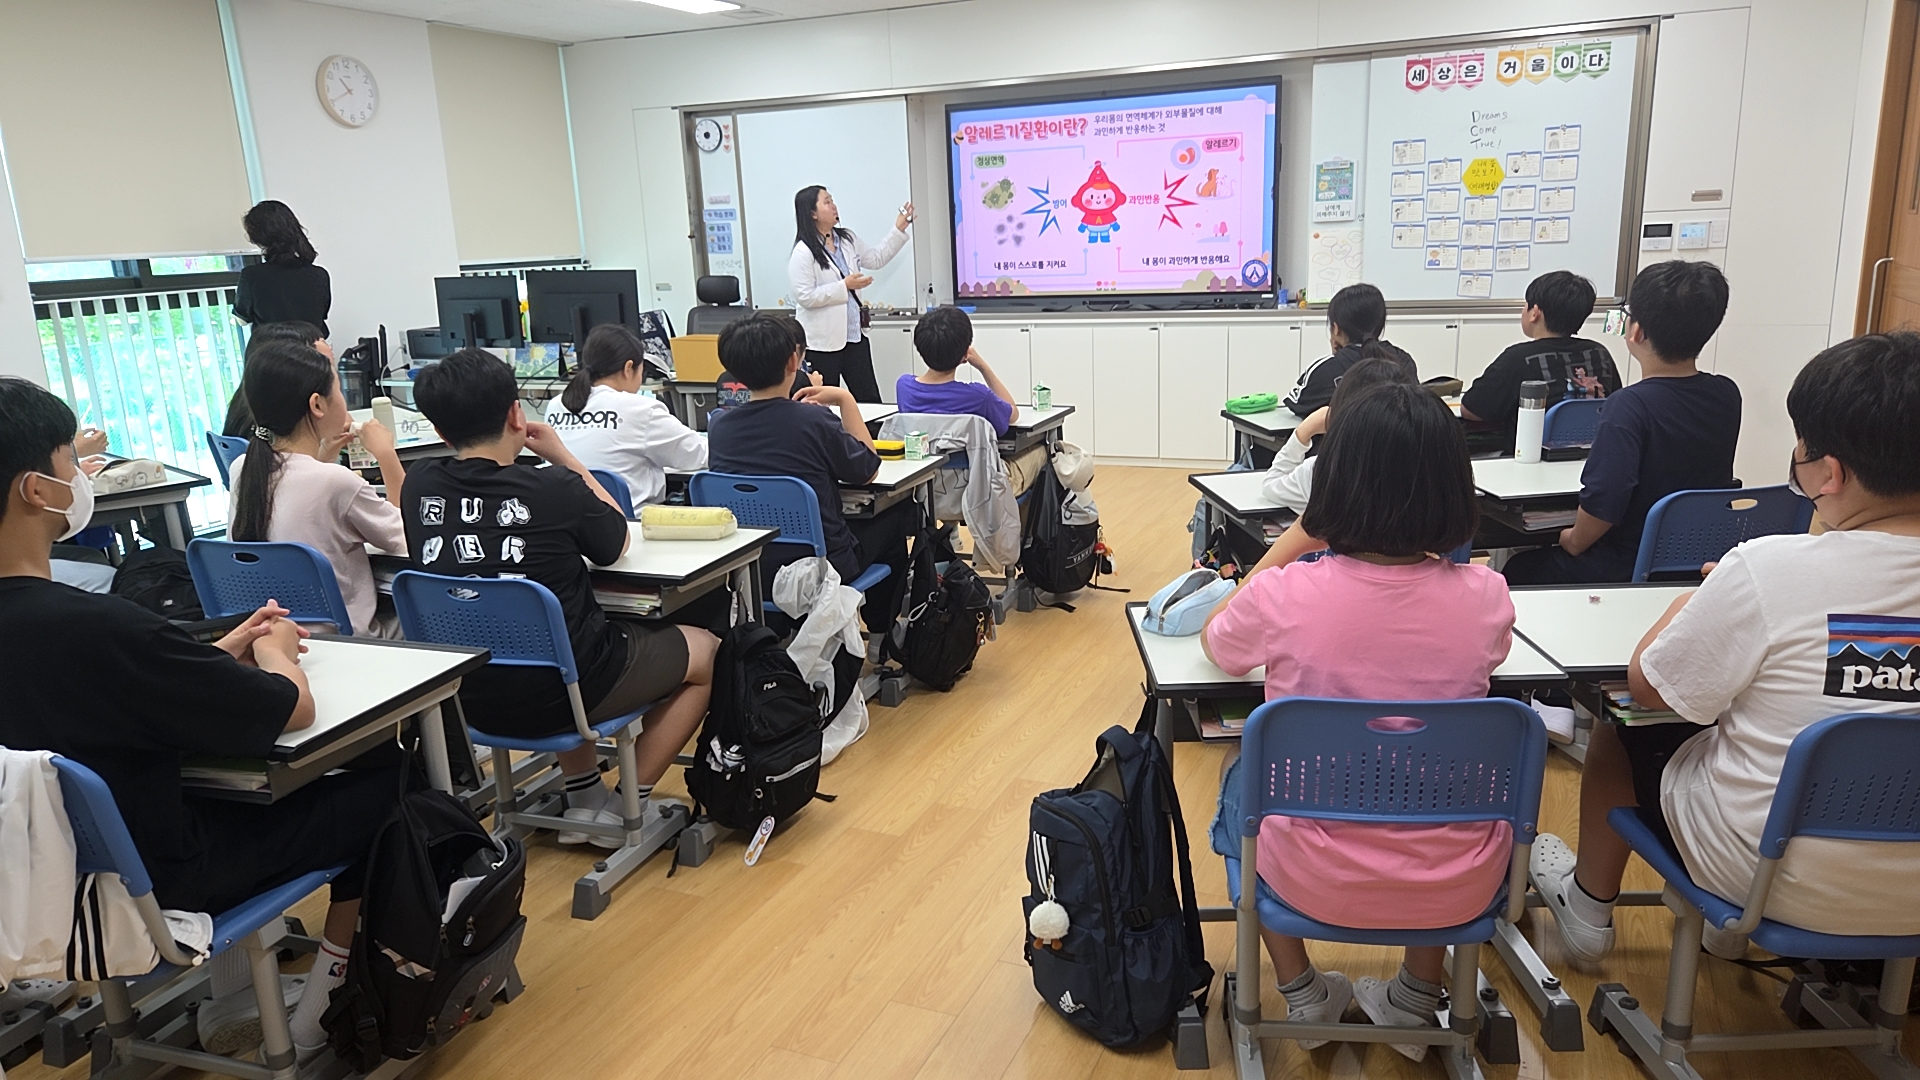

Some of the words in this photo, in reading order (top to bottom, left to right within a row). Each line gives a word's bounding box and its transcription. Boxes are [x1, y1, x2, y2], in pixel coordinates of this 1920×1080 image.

[1411, 64, 1477, 82] 세상은
[1503, 53, 1603, 74] 거울이다
[363, 75, 369, 84] 2
[368, 89, 374, 98] 3
[360, 111, 366, 120] 5
[1094, 113, 1123, 125] 우리몸의
[1125, 110, 1163, 122] 면역체계가
[1165, 107, 1204, 119] 외부물질에
[1206, 105, 1223, 115] 대해
[1472, 110, 1508, 123] Dreams
[964, 117, 1088, 145] 알레르기질환이란?
[1093, 126, 1123, 137] 과민하게
[1125, 123, 1156, 135] 반응하는
[1157, 122, 1166, 133] 것
[1470, 125, 1497, 137] Come
[1205, 137, 1237, 150] 알레르기
[1128, 194, 1160, 205] 과민반응
[1003, 261, 1016, 270] 몸이
[1152, 257, 1167, 266] 몸이
[1168, 255, 1198, 265] 과민하게
[1200, 255, 1230, 265] 반응해요
[548, 410, 619, 430] OUTDOOR
[1840, 663, 1920, 694] pat
[763, 681, 777, 691] FILA
